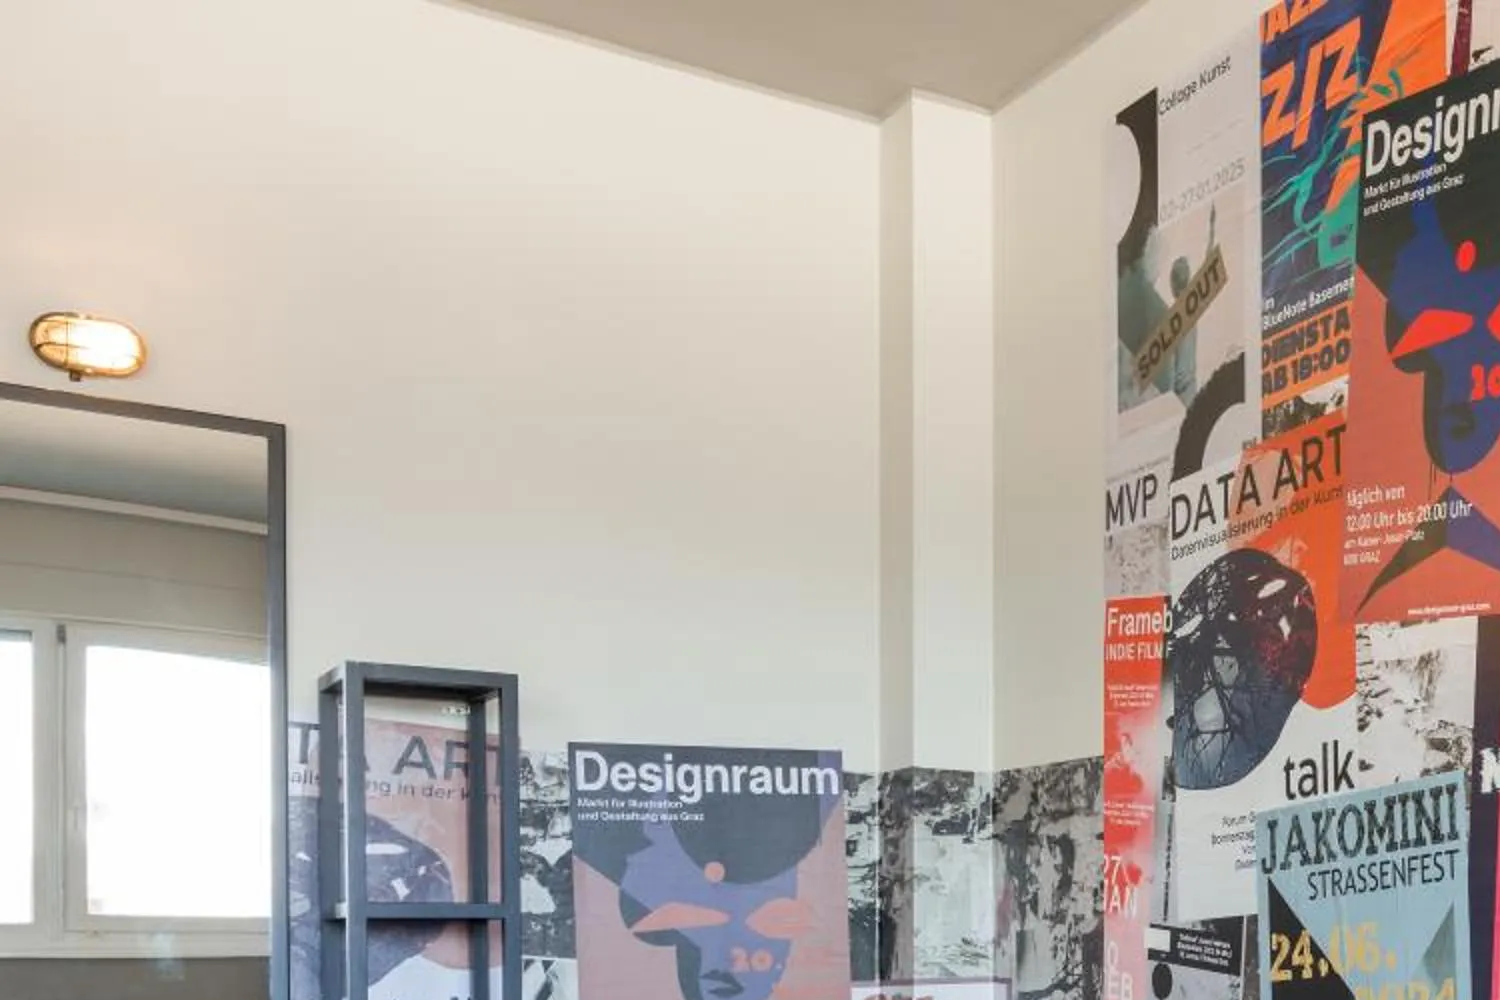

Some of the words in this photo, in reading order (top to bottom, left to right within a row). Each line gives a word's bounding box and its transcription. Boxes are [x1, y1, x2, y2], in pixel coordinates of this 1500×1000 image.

[1158, 80, 1197, 116] Collage
[1200, 55, 1231, 89] Kunst
[1138, 311, 1182, 379] SOLD
[1185, 257, 1220, 317] OUT
[1106, 472, 1158, 532] MVP
[1171, 463, 1261, 540] DATA
[1273, 424, 1346, 499] ART
[1397, 508, 1415, 526] bis
[1449, 498, 1473, 519] Uhr
[1107, 603, 1173, 637] Frameb
[574, 749, 840, 804] Designraum
[1284, 739, 1355, 800] talk
[1261, 781, 1460, 875] JAKOMINI
[1307, 849, 1460, 900] STRASSENFEST
